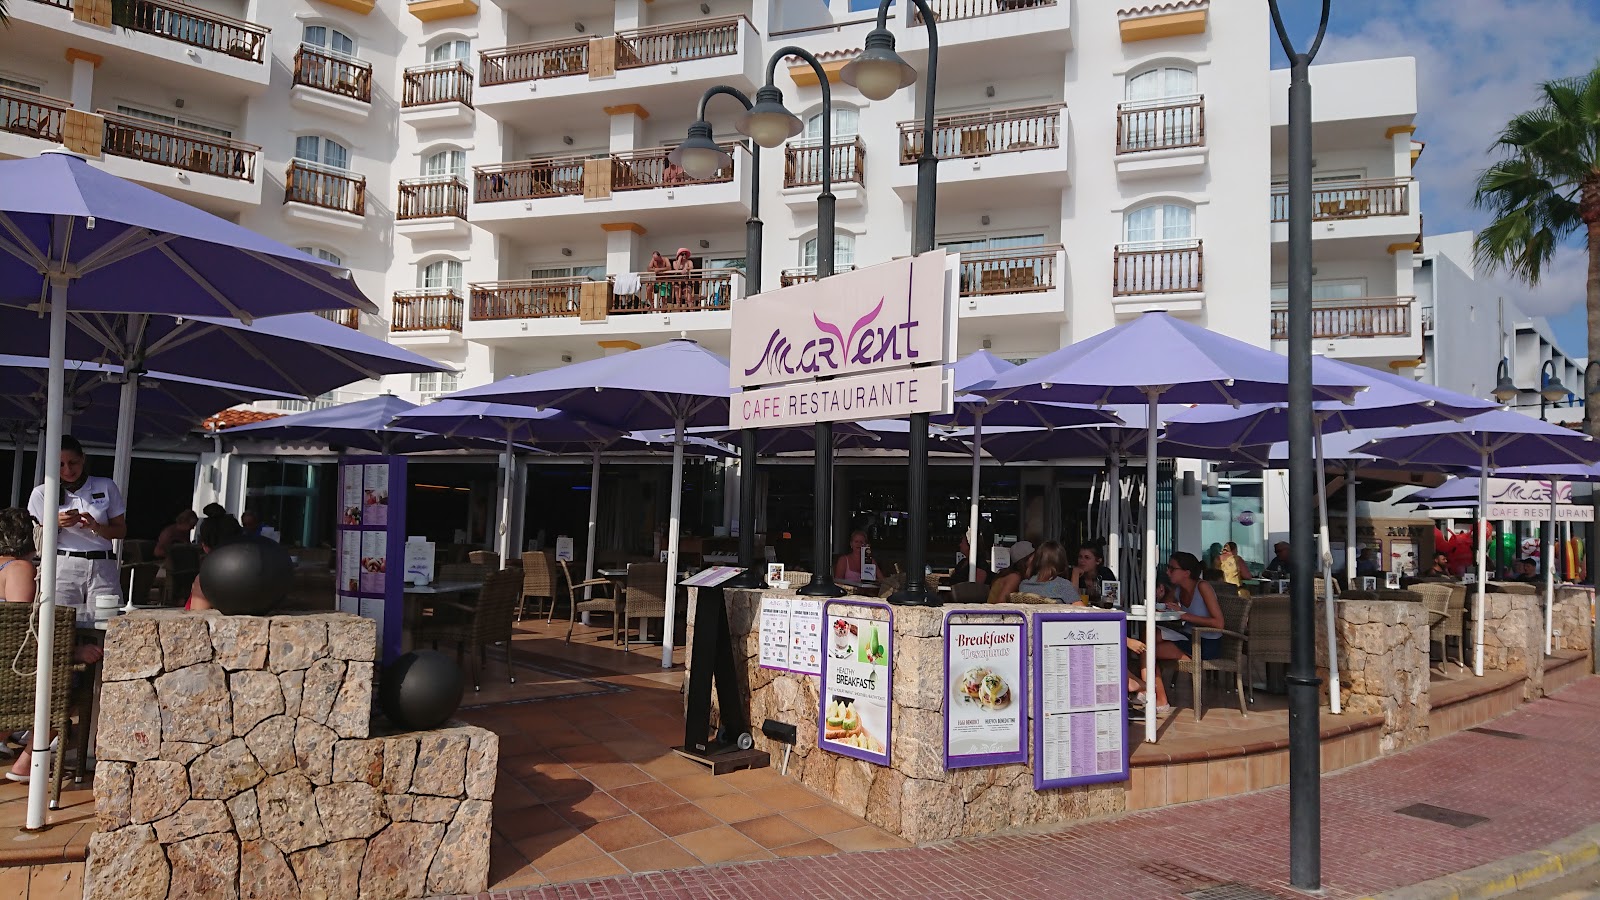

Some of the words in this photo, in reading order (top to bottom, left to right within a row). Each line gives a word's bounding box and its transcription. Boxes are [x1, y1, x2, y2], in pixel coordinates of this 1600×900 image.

[1492, 508, 1518, 517] CAFE
[955, 631, 1015, 649] Breakfasts
[836, 667, 855, 676] HEALTHY
[836, 674, 876, 690] BREAKFASTS
